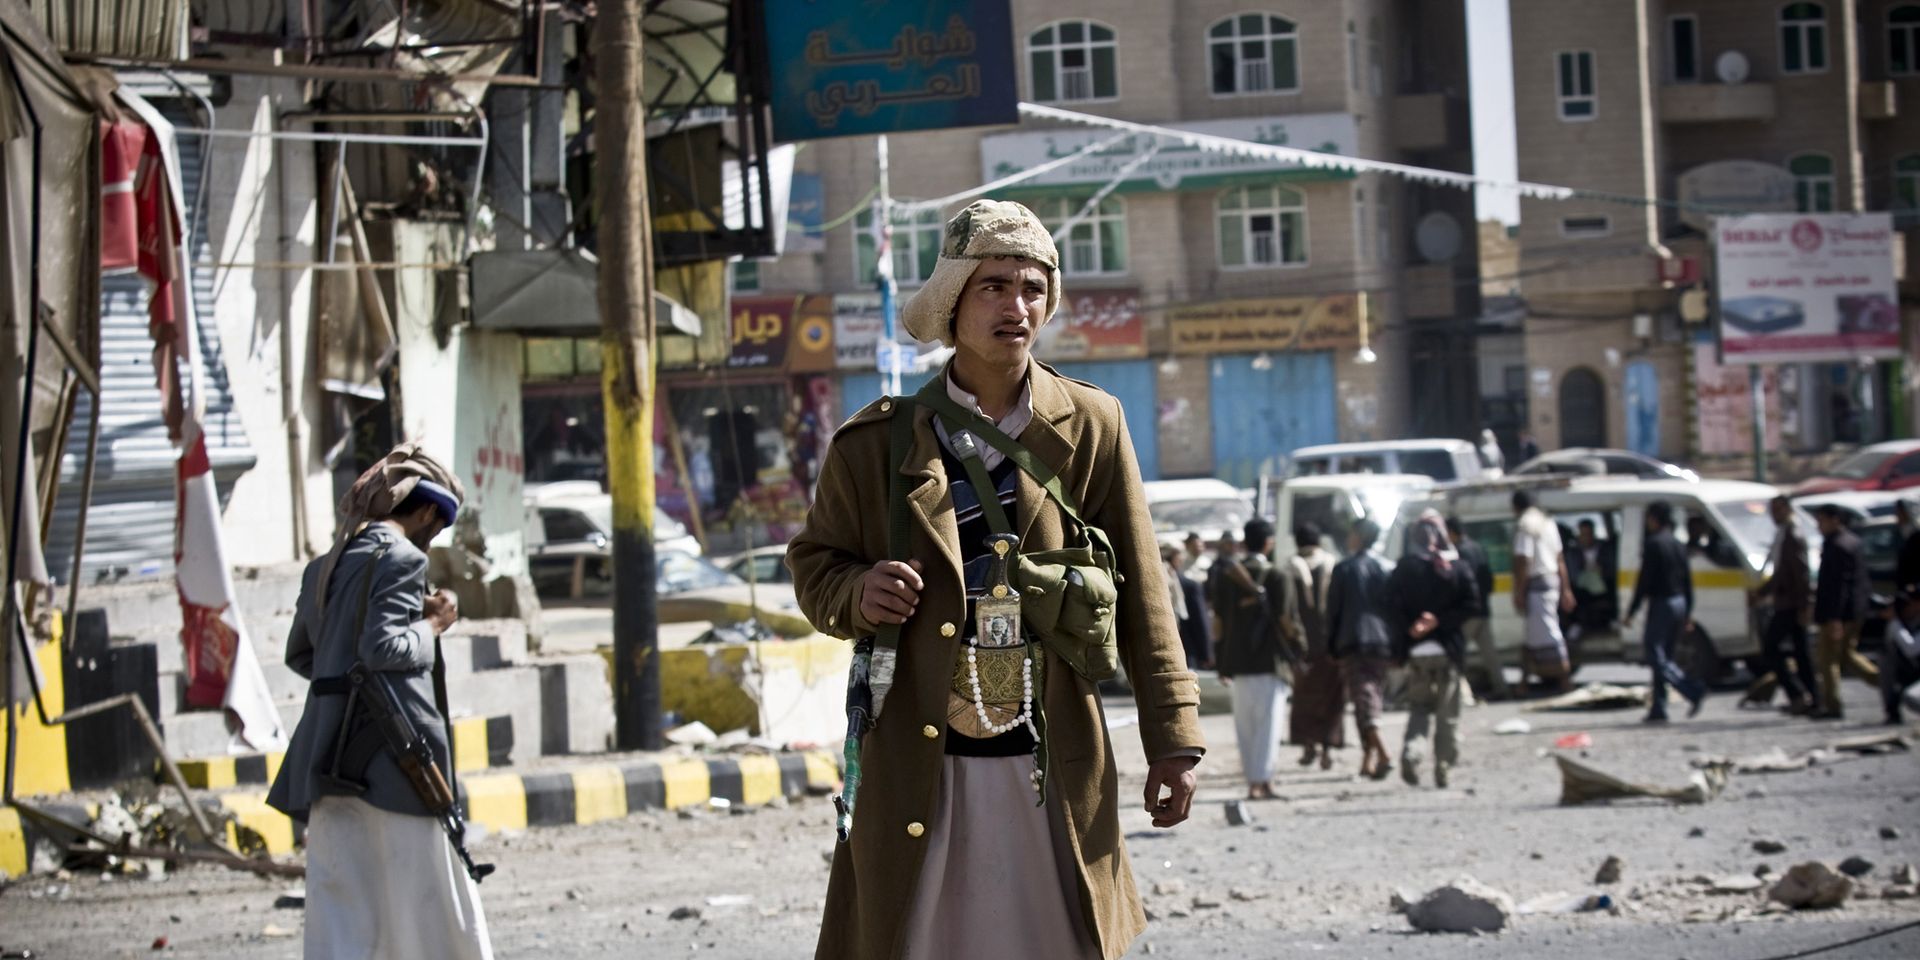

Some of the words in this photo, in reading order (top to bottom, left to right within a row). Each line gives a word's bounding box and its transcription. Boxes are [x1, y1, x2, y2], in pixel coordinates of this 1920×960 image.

[806, 14, 976, 71] شواية
[806, 64, 981, 128] العربي
[732, 309, 783, 345] ديار
